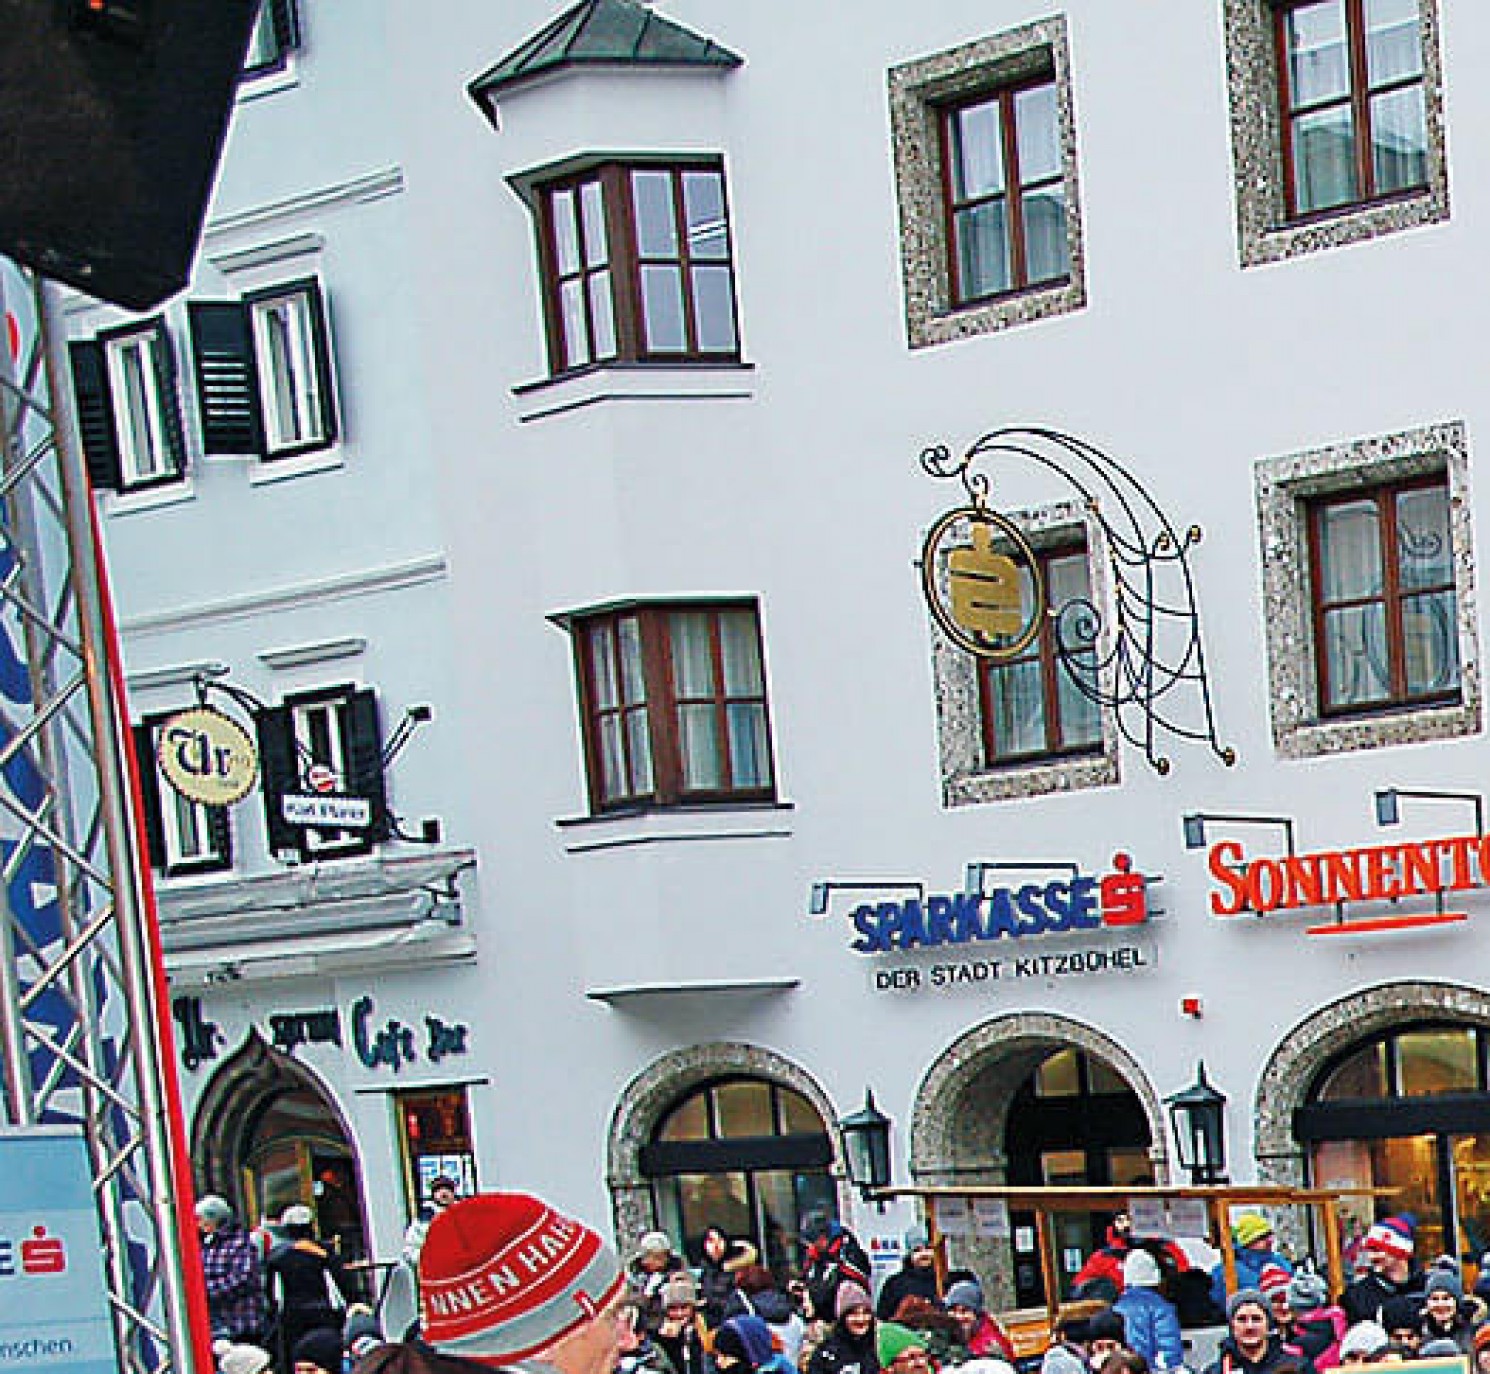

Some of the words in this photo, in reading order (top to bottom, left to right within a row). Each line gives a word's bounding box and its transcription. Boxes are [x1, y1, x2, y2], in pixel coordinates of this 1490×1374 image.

[851, 876, 1099, 953] SPARKASSE
[876, 970, 921, 990] DER
[930, 960, 1002, 986] STADT
